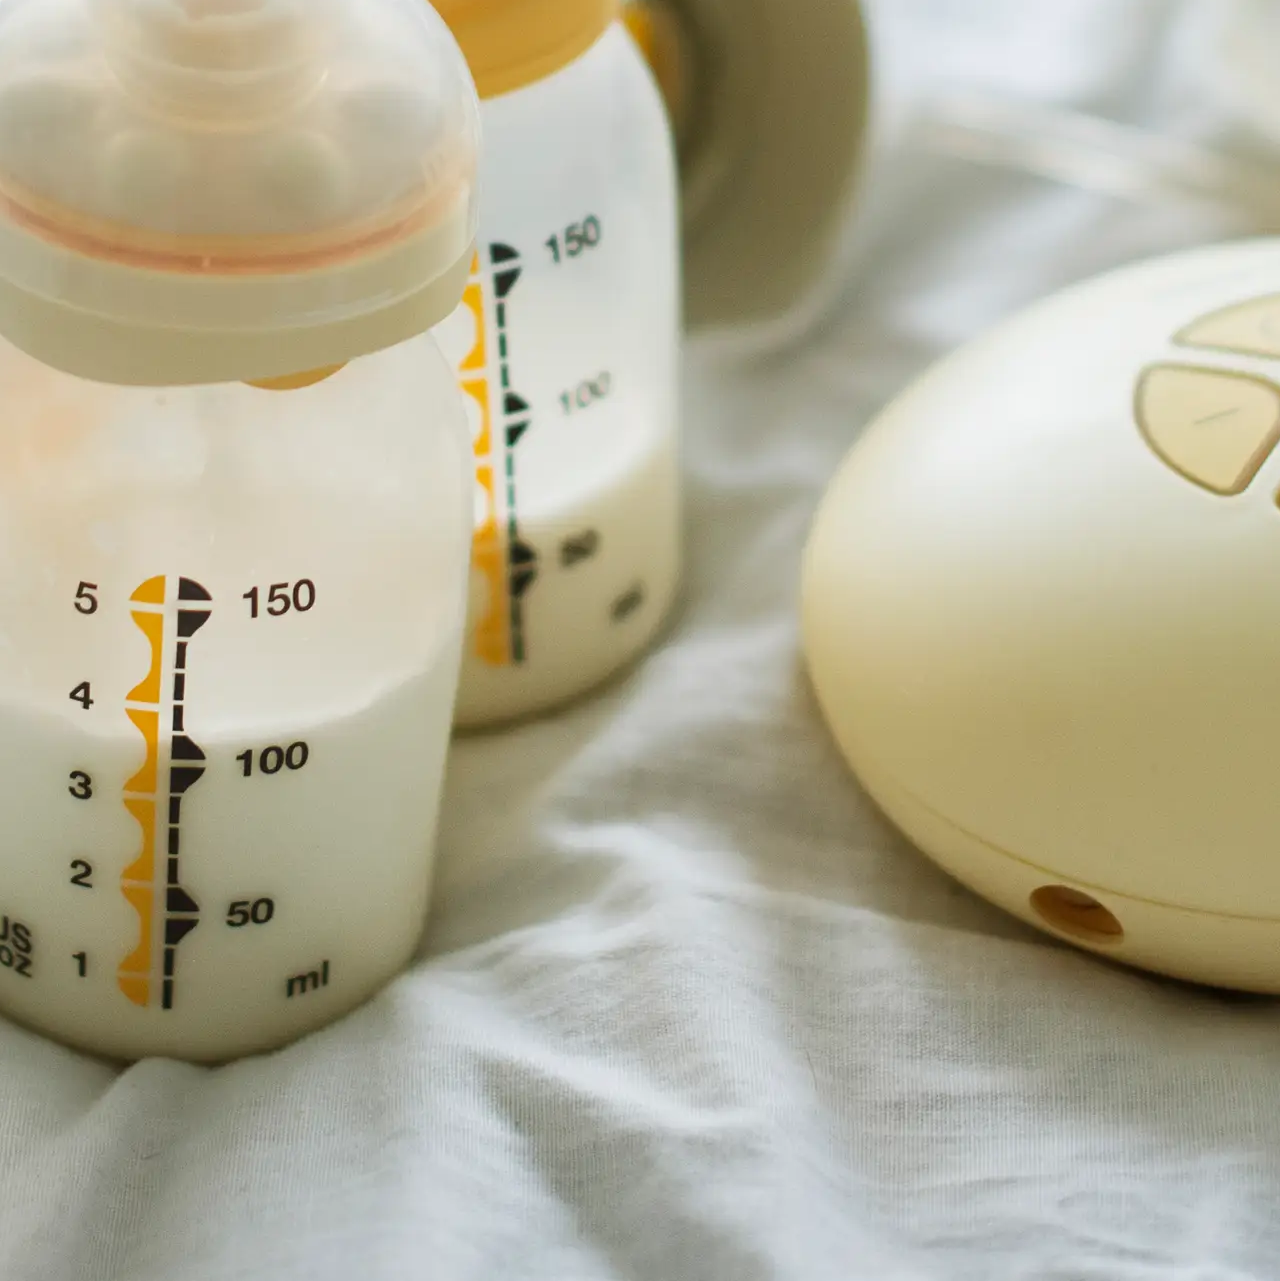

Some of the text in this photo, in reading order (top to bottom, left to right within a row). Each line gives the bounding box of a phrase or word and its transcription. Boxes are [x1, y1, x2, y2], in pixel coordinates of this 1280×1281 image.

[544, 214, 601, 265] 150
[557, 370, 613, 416] 100
[73, 580, 98, 615] 5
[242, 578, 317, 618] 150
[68, 681, 94, 710] 4
[235, 741, 309, 777] 100
[68, 771, 93, 800] 3
[70, 859, 93, 888] 2
[225, 897, 275, 928] 50
[71, 952, 88, 978] 1
[285, 960, 330, 998] ml
